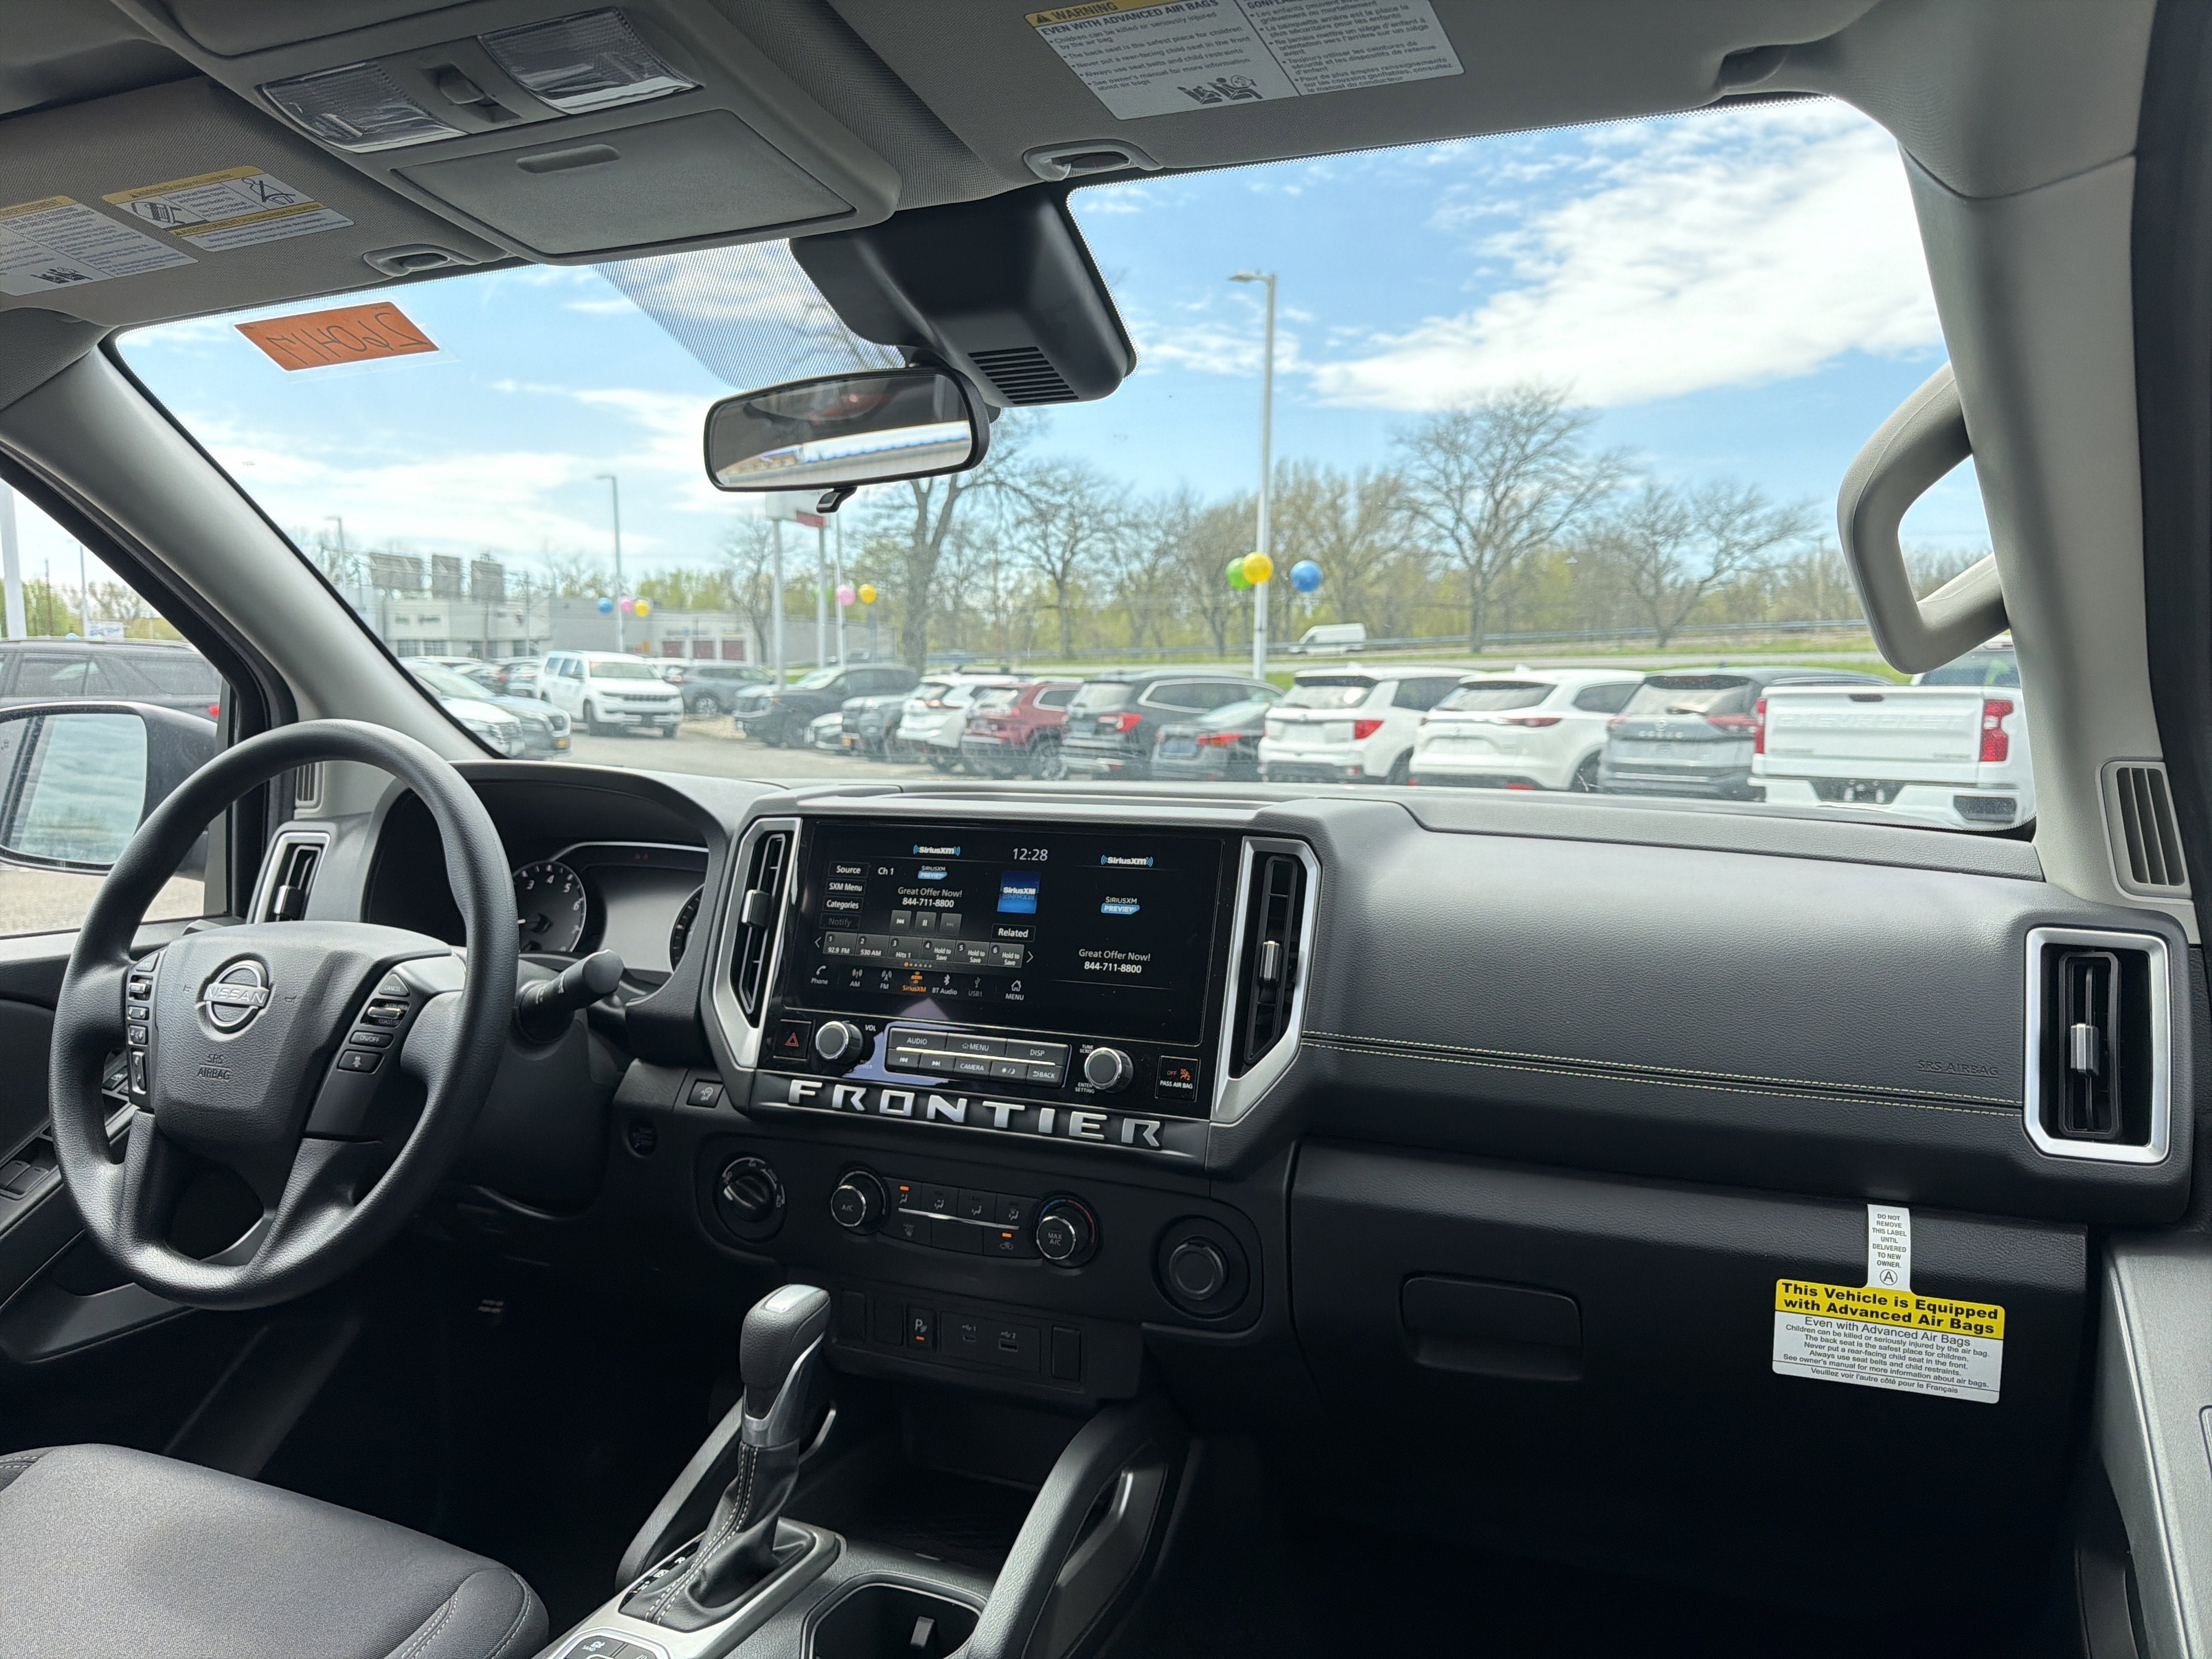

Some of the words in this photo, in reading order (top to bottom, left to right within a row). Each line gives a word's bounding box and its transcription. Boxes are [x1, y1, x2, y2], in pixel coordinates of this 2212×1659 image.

[1052, 2, 1118, 21] WARNING
[1042, 24, 1071, 36] EVEN
[1074, 19, 1102, 32] WITH
[1104, 8, 1164, 25] ADVANCED
[1165, 4, 1186, 14] AIR
[1013, 848, 1048, 861] 12:28
[836, 865, 861, 874] Source
[829, 882, 843, 890] SXM
[845, 883, 862, 891] Menu
[898, 887, 918, 895] Great
[920, 888, 940, 896] Offer
[942, 889, 962, 897] Now!
[827, 900, 859, 910] Categories
[902, 898, 954, 907] 844-711-8800
[828, 918, 851, 927] Notify
[998, 928, 1029, 938] Related
[1079, 949, 1102, 960] Great
[1103, 950, 1126, 960] Offer
[1128, 952, 1150, 961] Now!
[1084, 961, 1142, 973] 844-711-8800
[208, 985, 266, 1003] NISSAN
[907, 1037, 928, 1045] AUDIO
[970, 1043, 990, 1052] MENU
[208, 1054, 223, 1064] SRS
[960, 1063, 984, 1071] CAMERA
[1917, 1060, 1943, 1070] SRS
[1946, 1062, 1999, 1076] AIRBAG
[197, 1068, 232, 1081] AIRBAG
[1039, 1070, 1055, 1079] BACK
[788, 1079, 1160, 1147] FRONTIER
[1872, 1243, 1907, 1252] DELIVERED
[1877, 1260, 1902, 1268] OWNER.
[1781, 1282, 1818, 1296] This
[1824, 1287, 1887, 1305] Vehicle
[1894, 1296, 1908, 1308] is
[1915, 1299, 1997, 1319] Equipped
[1784, 1299, 1820, 1311] with
[1826, 1302, 1911, 1323] Advanced
[1917, 1314, 1944, 1327] Air
[1950, 1317, 1994, 1334] Bags
[1805, 1316, 1832, 1328] Even
[1836, 1322, 1858, 1331] with
[1861, 1324, 1918, 1339] Advanced
[1921, 1331, 1938, 1341] Air
[1941, 1334, 1970, 1347] Bags
[1786, 1324, 1815, 1334] Children
[1843, 1331, 1863, 1340] killed
[1874, 1336, 1906, 1347] seriously
[1909, 1340, 1934, 1349] injured
[1936, 1344, 1945, 1352] by
[1973, 1348, 1989, 1358] bag.
[1804, 1341, 1826, 1350] Never
[1847, 1348, 1887, 1359] rear-facing
[1949, 1361, 1967, 1369] front.
[1820, 1336, 1837, 1344] back
[1937, 1352, 1968, 1362] children.
[1809, 1350, 1835, 1359] Always
[1870, 1357, 1887, 1365] belts
[1925, 1367, 1961, 1376] restraints.
[1799, 1357, 1827, 1365] owner's
[1890, 1368, 1931, 1379] information
[1933, 1374, 1954, 1383] about
[1968, 1379, 1989, 1388] bags.
[1810, 1367, 1839, 1376] Veuillez
[1856, 1373, 1878, 1382] l'autre
[1926, 1383, 1958, 1393] Français
